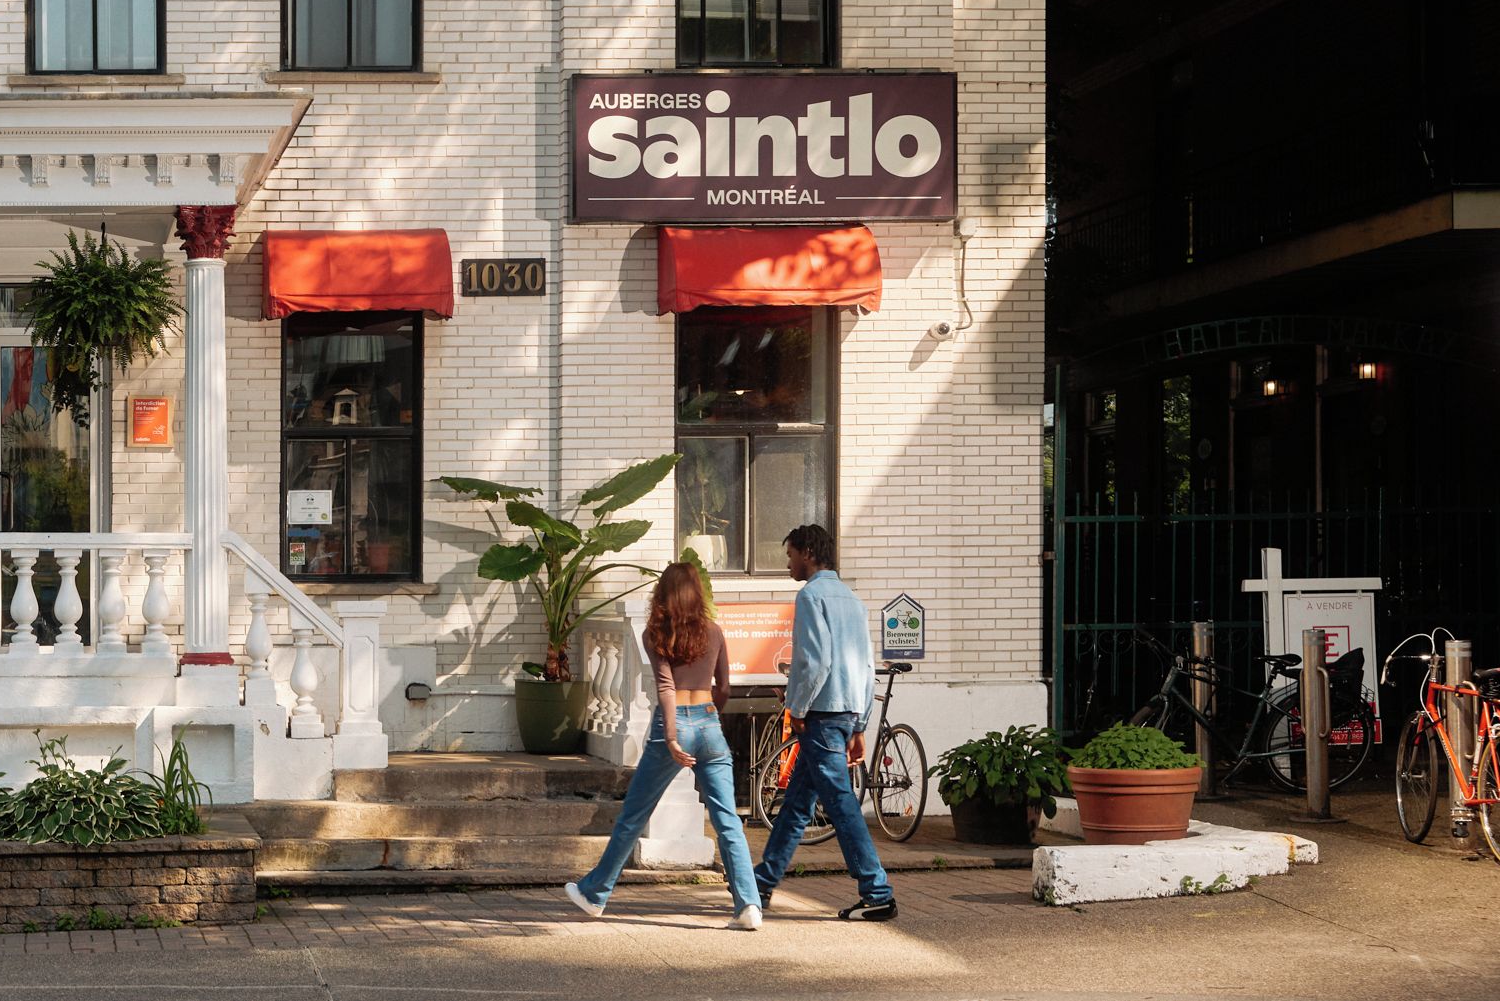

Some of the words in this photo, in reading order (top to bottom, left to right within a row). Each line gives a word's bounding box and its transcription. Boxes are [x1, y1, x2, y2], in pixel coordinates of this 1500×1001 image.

[588, 93, 701, 110] AUBERGES
[587, 90, 942, 179] saintlo
[707, 185, 826, 206] MONTRÉAL
[466, 263, 544, 292] 1030
[1306, 600, 1314, 610] À
[1316, 601, 1354, 610] VENDRE
[886, 630, 920, 638] Bienvenue
[888, 637, 918, 646] cyclistes!
